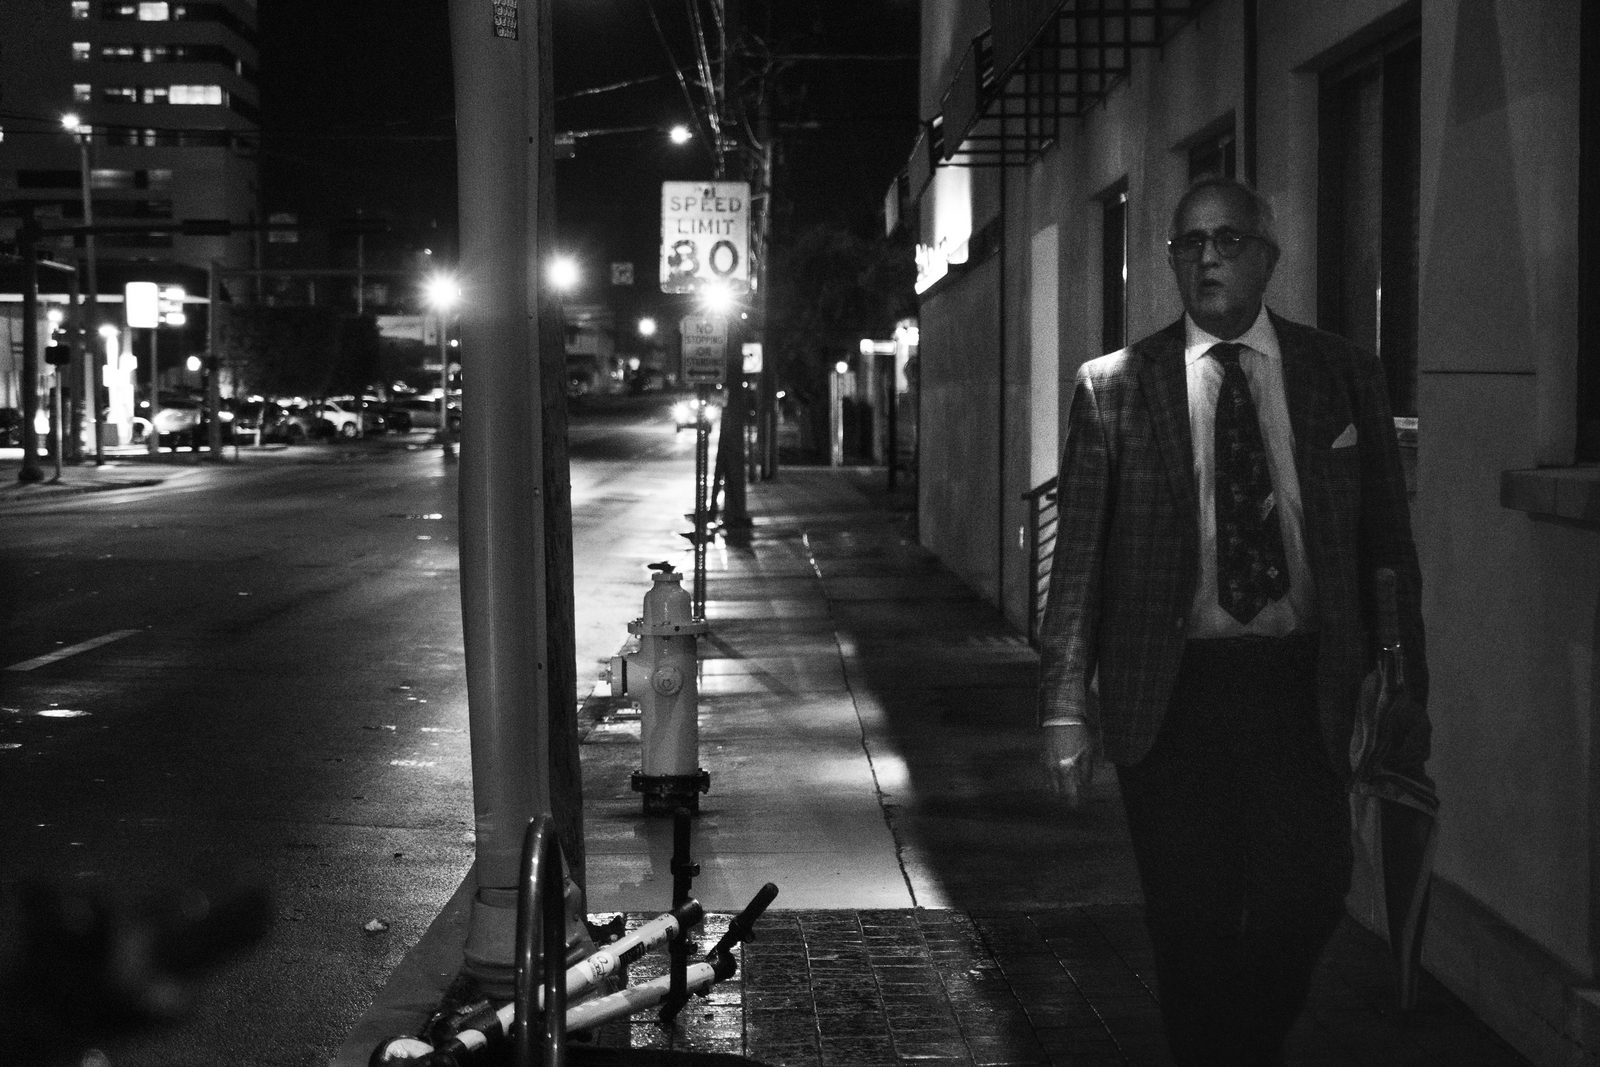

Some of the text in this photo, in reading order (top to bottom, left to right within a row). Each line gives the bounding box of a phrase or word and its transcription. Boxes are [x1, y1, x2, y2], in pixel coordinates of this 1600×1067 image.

[670, 196, 742, 212] SPEED
[678, 219, 735, 235] LIMIT
[696, 323, 714, 334] NO
